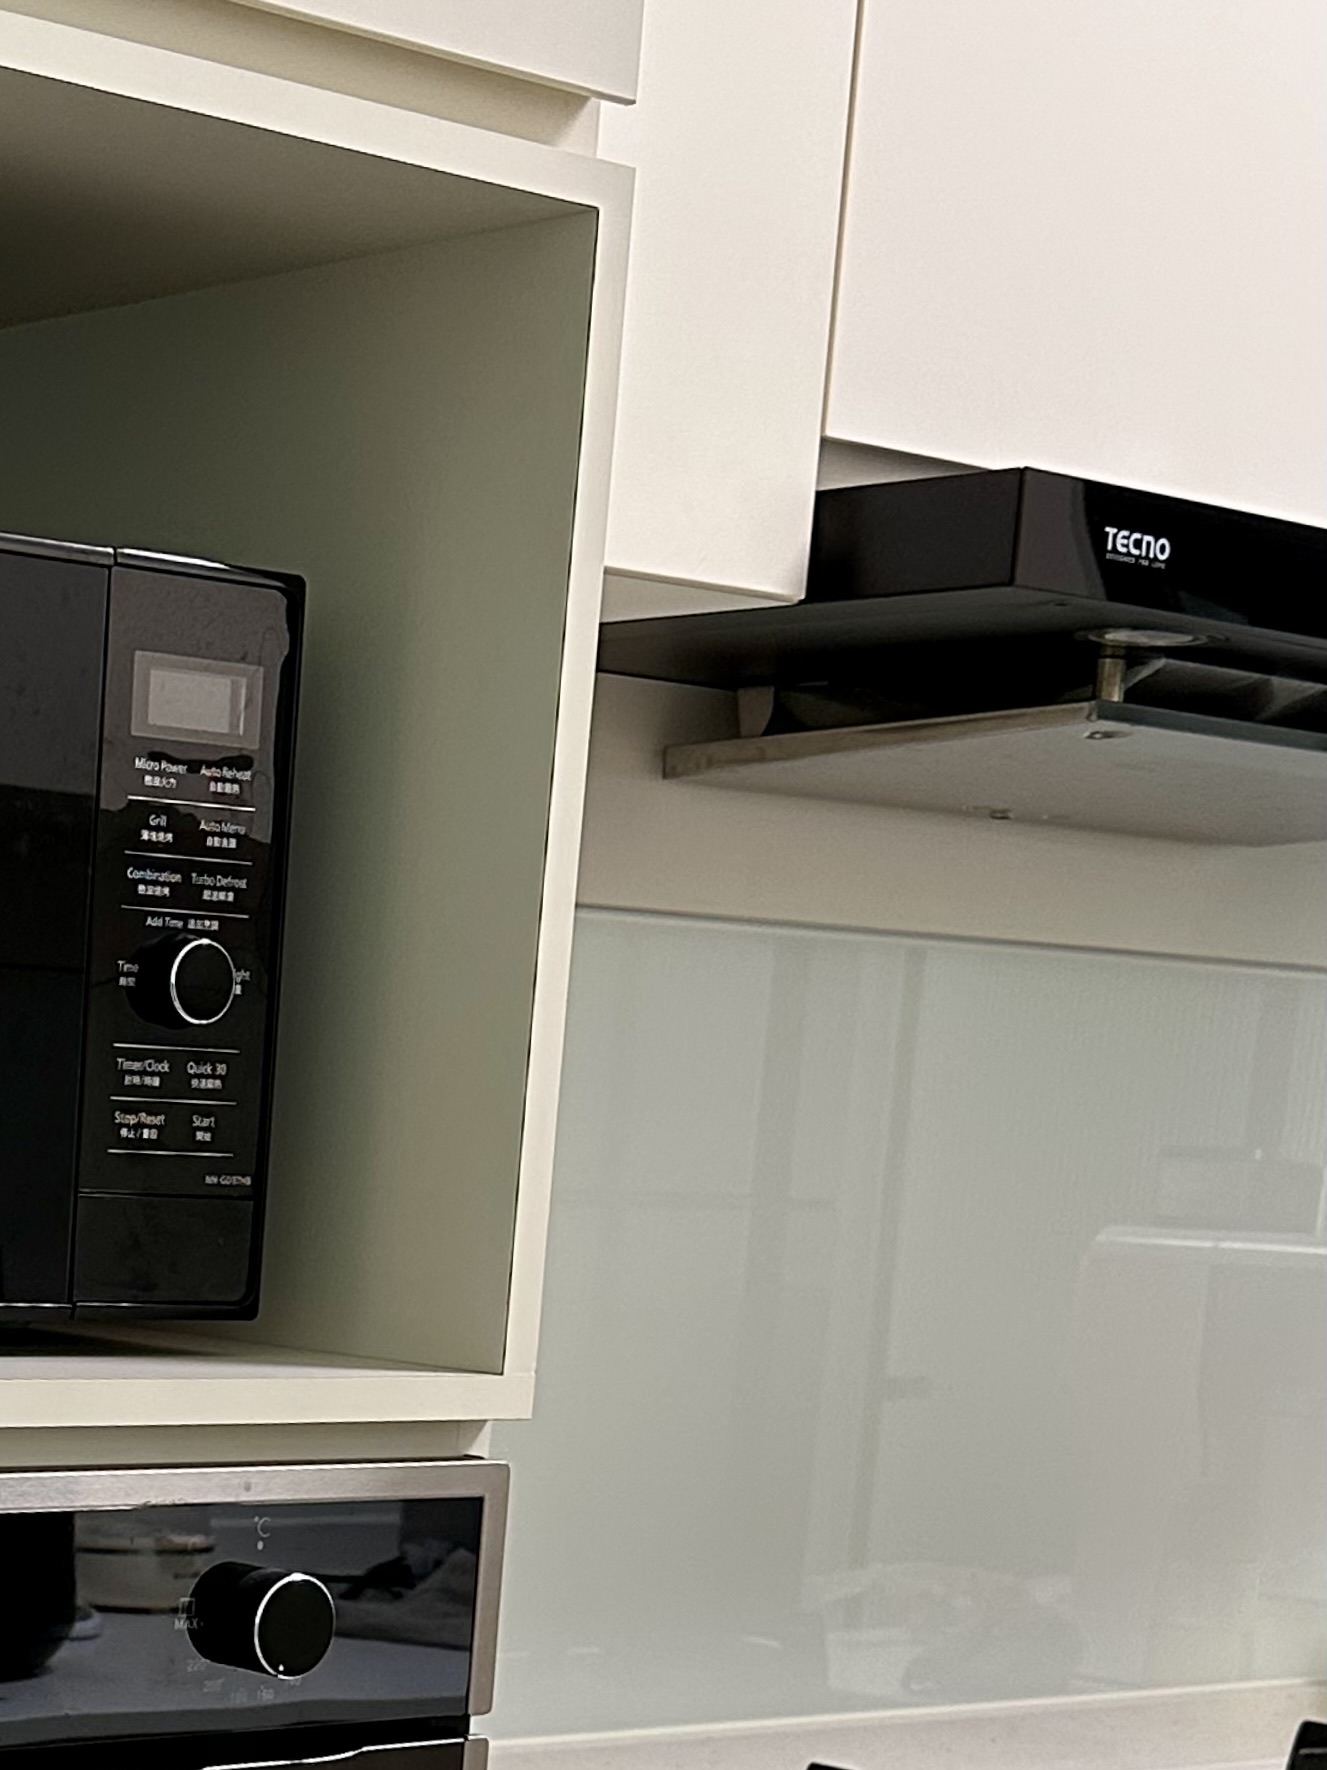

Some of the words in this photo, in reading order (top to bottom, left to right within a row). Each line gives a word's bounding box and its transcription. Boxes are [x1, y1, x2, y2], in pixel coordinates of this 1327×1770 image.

[1104, 526, 1171, 561] TECNO
[135, 757, 159, 771] Micro
[161, 761, 187, 774] Power
[200, 765, 220, 778] Auto
[222, 767, 252, 781] Reheat
[149, 814, 167, 827] Grill
[199, 820, 220, 832] Auto
[222, 822, 246, 835] Menu
[127, 867, 182, 883] Combination
[191, 873, 215, 886] Turbo
[216, 875, 247, 889] Defrost
[145, 916, 163, 927] Add
[165, 917, 184, 929] Time
[117, 960, 139, 973] Time
[116, 1057, 170, 1073] Timer/Clock
[186, 1061, 212, 1075] Quick
[215, 1063, 227, 1076] 30
[114, 1111, 166, 1126] Stop/Reset
[192, 1115, 215, 1128] Start
